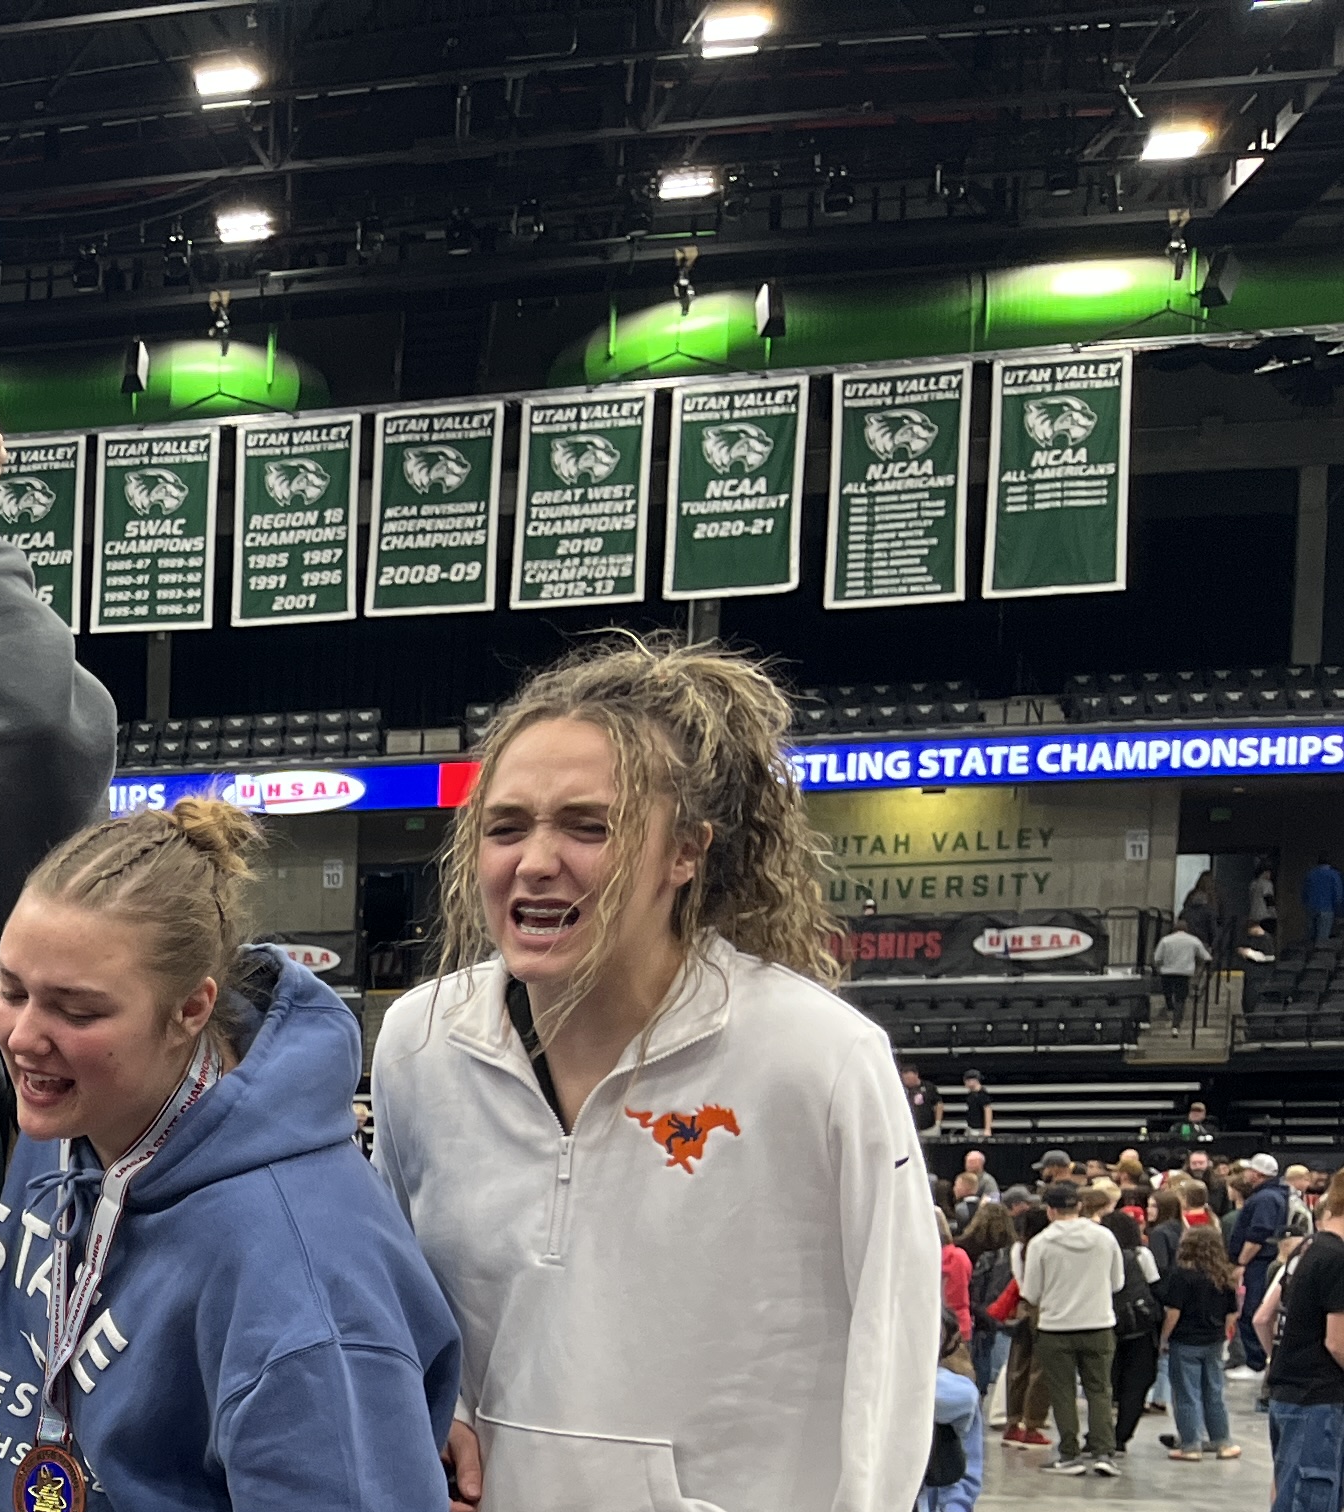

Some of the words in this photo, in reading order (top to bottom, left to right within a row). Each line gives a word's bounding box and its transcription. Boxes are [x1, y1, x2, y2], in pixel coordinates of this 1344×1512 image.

[1004, 368, 1052, 384] UTAH
[1056, 362, 1122, 380] VALLEY
[844, 381, 892, 397] UTAH
[896, 375, 961, 393] VALLEY
[683, 396, 730, 411] UTAH
[734, 389, 798, 408] VALLEY
[532, 407, 577, 424] UTAH
[581, 401, 644, 420] VALLEY
[385, 418, 429, 434] UTAH
[433, 413, 493, 430] VALLEY
[247, 433, 289, 447] UTAH
[292, 426, 351, 445] VALLEY
[20, 447, 76, 463] VALLEY
[107, 442, 148, 457] UTAH
[152, 439, 209, 455] VALLEY
[1031, 447, 1087, 467] NCAA
[19, 460, 75, 473] BASKETBALL
[866, 459, 933, 480] NJCAA
[1001, 463, 1116, 482] ALL-AMERICANS
[531, 488, 585, 505] GREAT
[587, 484, 635, 500] WEST
[705, 476, 767, 499] NCAA
[842, 474, 956, 495] ALL-AMERICANS
[385, 506, 418, 519] NCAA
[420, 502, 478, 516] DIVISION
[530, 499, 636, 519] TOURNAMENT
[681, 494, 790, 516] TOURNAMENT
[125, 518, 187, 538] SWAC
[249, 510, 319, 530] REGION
[323, 508, 344, 524] 18
[382, 515, 486, 534] INDEPENDENT
[526, 514, 637, 537] CHAMPIONS
[693, 517, 775, 539] 2020-21
[104, 536, 205, 555] CHAMPIONS
[245, 526, 347, 547] CHAMPIONS
[380, 529, 487, 551] CHAMPIONS
[556, 537, 604, 555] 2010
[29, 550, 73, 567] FOUR
[248, 553, 289, 568] 1985
[302, 549, 343, 565] 1987
[249, 574, 287, 590] 1991
[301, 569, 342, 587] 1996
[379, 561, 482, 586] 2008-09
[524, 564, 633, 584] CHAMPIONS
[540, 579, 615, 598] 2012-13
[272, 593, 317, 611] 2001
[917, 745, 1030, 779] STATE
[1036, 735, 1344, 775] CHAMPIONSHIPS
[241, 780, 351, 798] UHSAA
[832, 834, 911, 858] UTAH
[932, 828, 1054, 853] VALLEY
[325, 872, 340, 886] 10
[828, 872, 1052, 901] UNIVERSITY
[988, 934, 1082, 948] UHSAA
